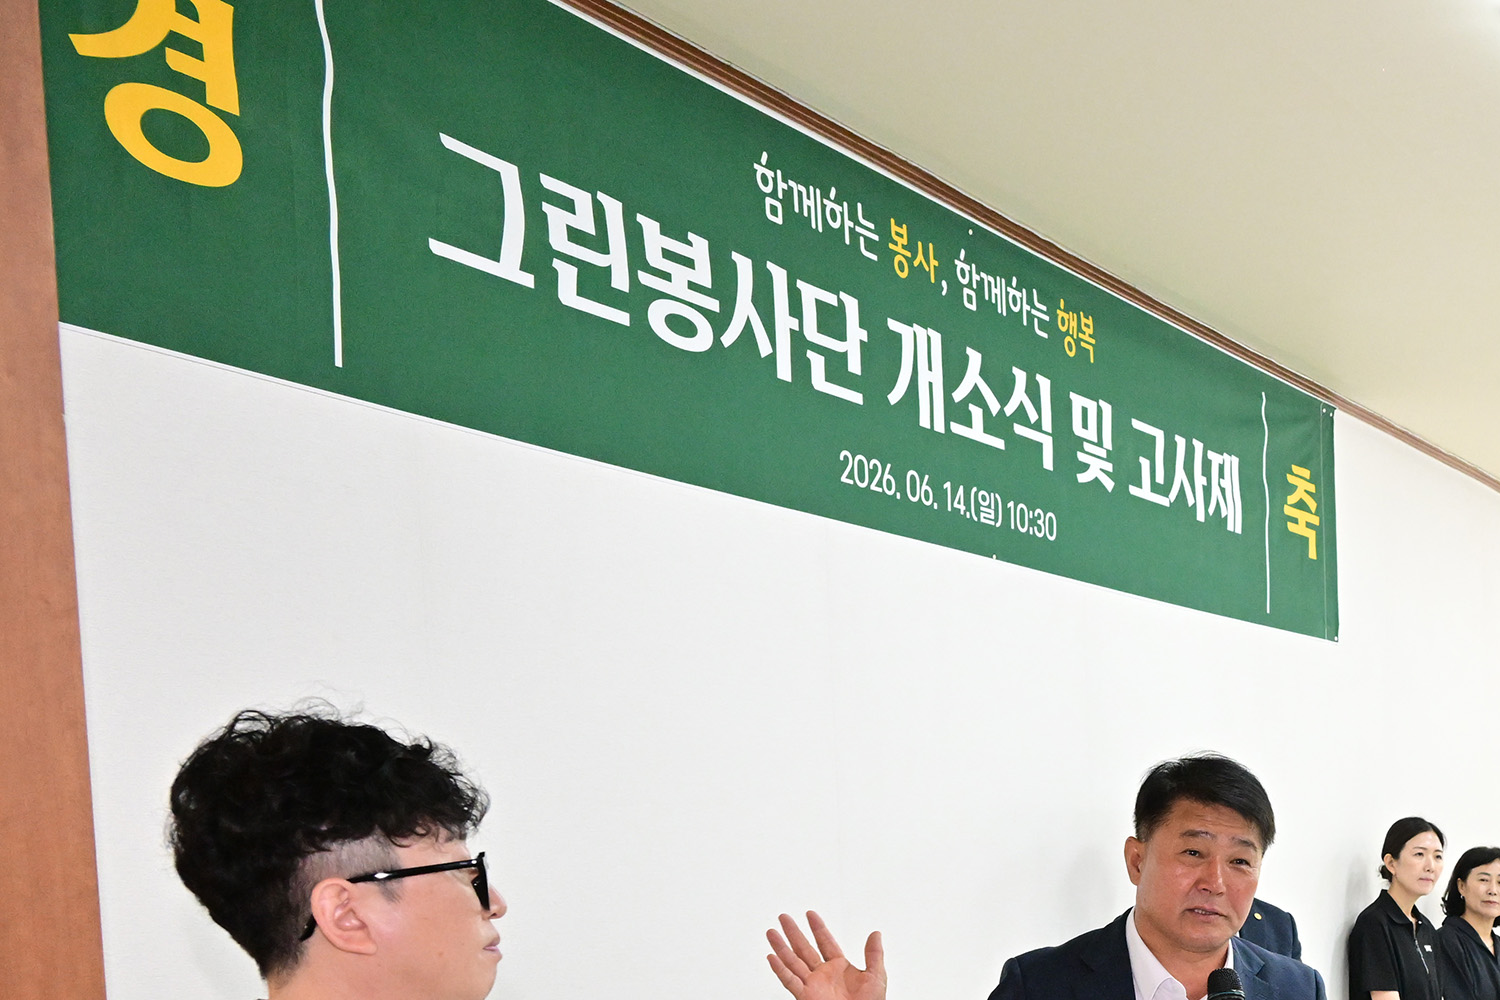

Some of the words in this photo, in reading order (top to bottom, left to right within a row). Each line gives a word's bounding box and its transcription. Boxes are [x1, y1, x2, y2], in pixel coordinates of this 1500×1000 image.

[428, 132, 868, 405] 그린봉사단
[886, 317, 1054, 472] 개소식
[1069, 391, 1115, 493] 및
[1128, 418, 1243, 534] 고사제
[753, 151, 879, 261] 함께하는
[888, 218, 948, 296] 봉사,
[954, 248, 1050, 339] 함께하는
[1056, 298, 1096, 363] 행복
[839, 449, 901, 500] 2026.
[906, 469, 938, 510] 06.
[1007, 500, 1057, 542] 10:30
[1283, 464, 1320, 560] 축
